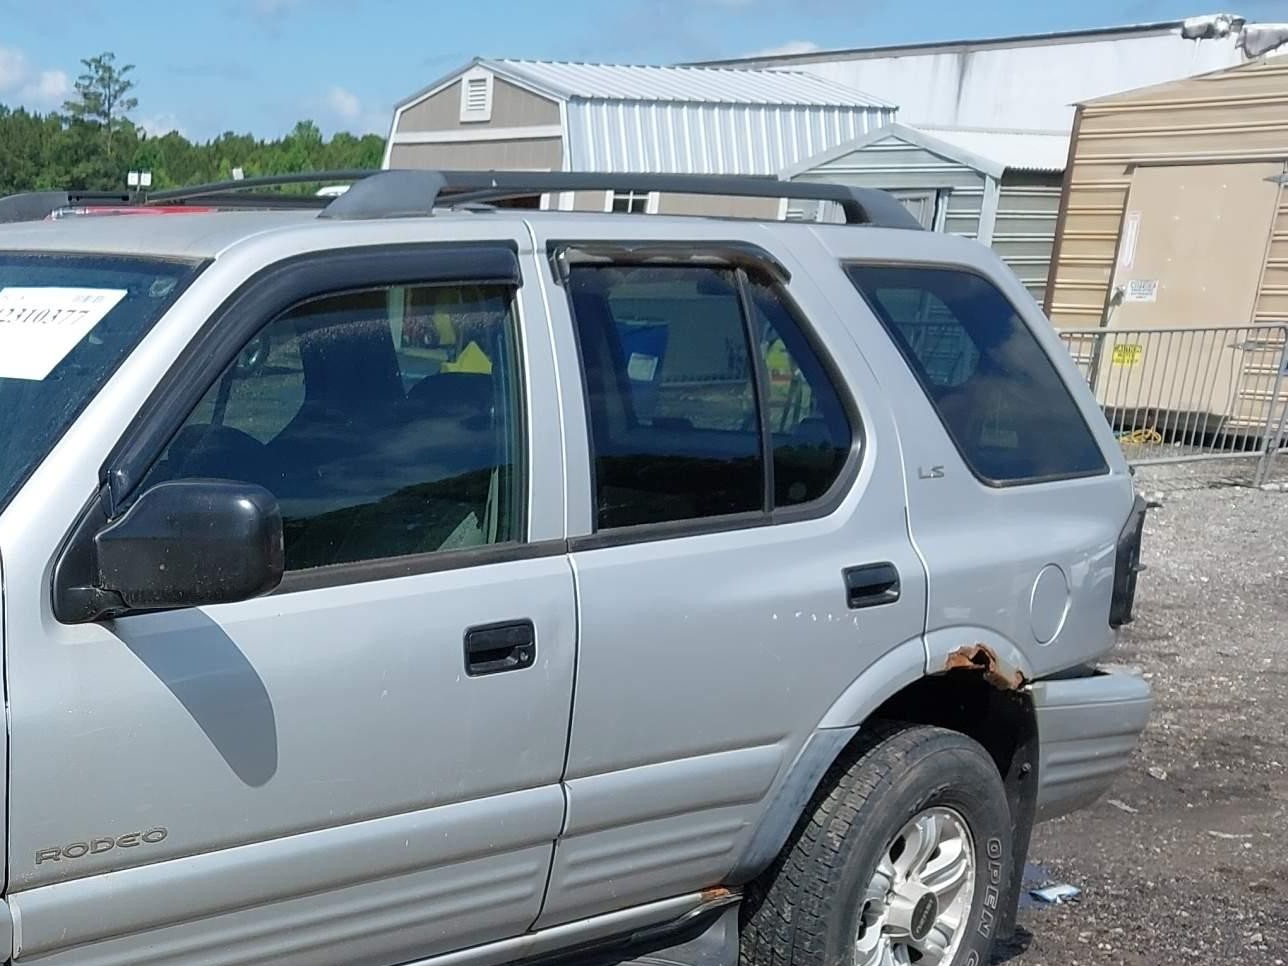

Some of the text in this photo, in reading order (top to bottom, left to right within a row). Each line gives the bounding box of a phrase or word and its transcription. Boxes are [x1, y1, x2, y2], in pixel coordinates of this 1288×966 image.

[918, 465, 945, 480] LS
[34, 826, 169, 865] RODEO
[976, 838, 1002, 939] OPEN
